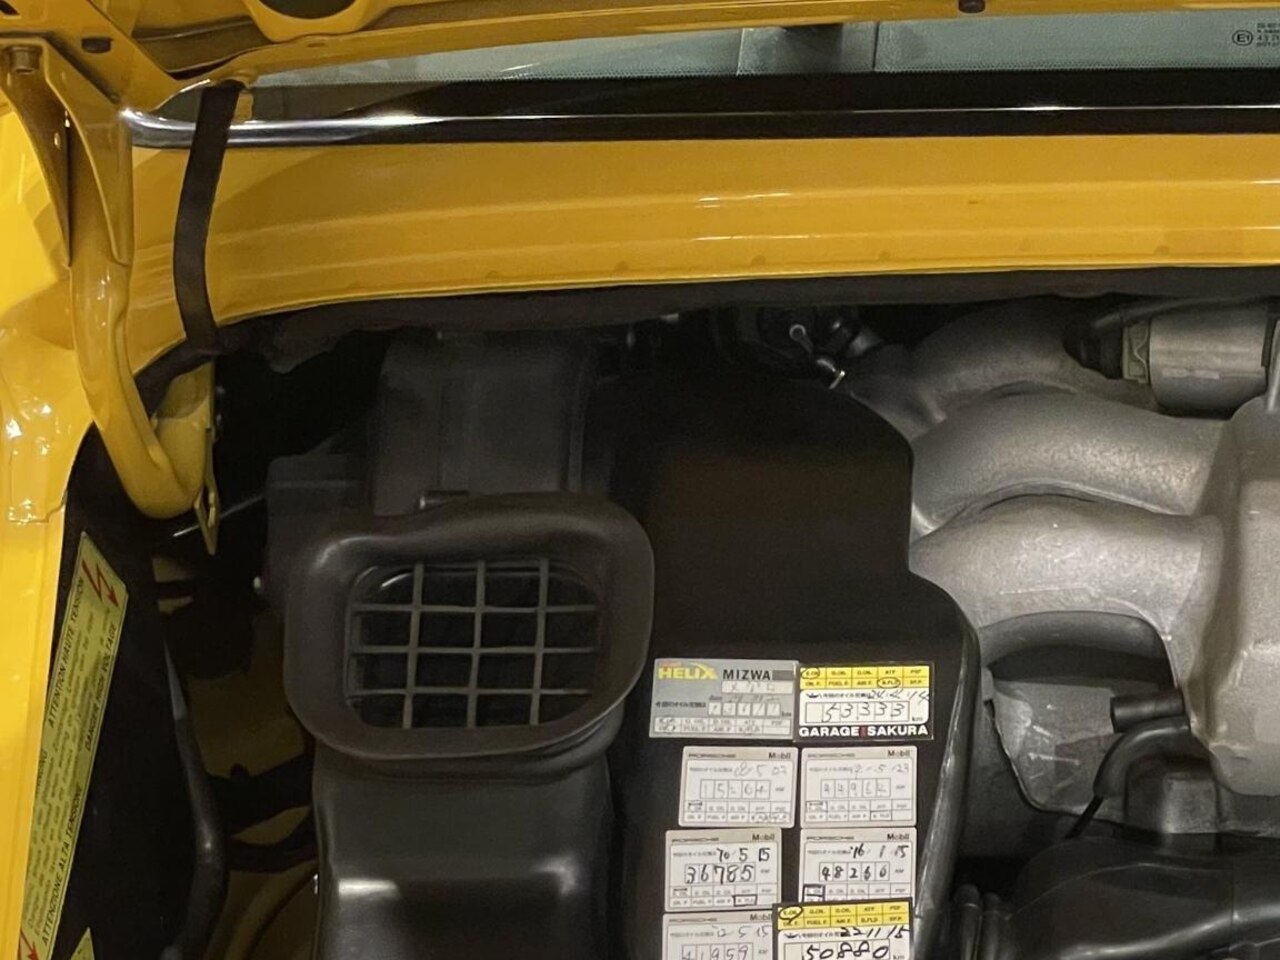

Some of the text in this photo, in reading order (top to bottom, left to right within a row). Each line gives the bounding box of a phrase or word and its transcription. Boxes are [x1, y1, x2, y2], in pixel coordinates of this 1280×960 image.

[658, 664, 719, 680] HELIX
[722, 669, 772, 681] MIZWA
[799, 725, 929, 737] GARAGE SAKURA
[739, 847, 749, 862] 5
[687, 863, 754, 886] 36785
